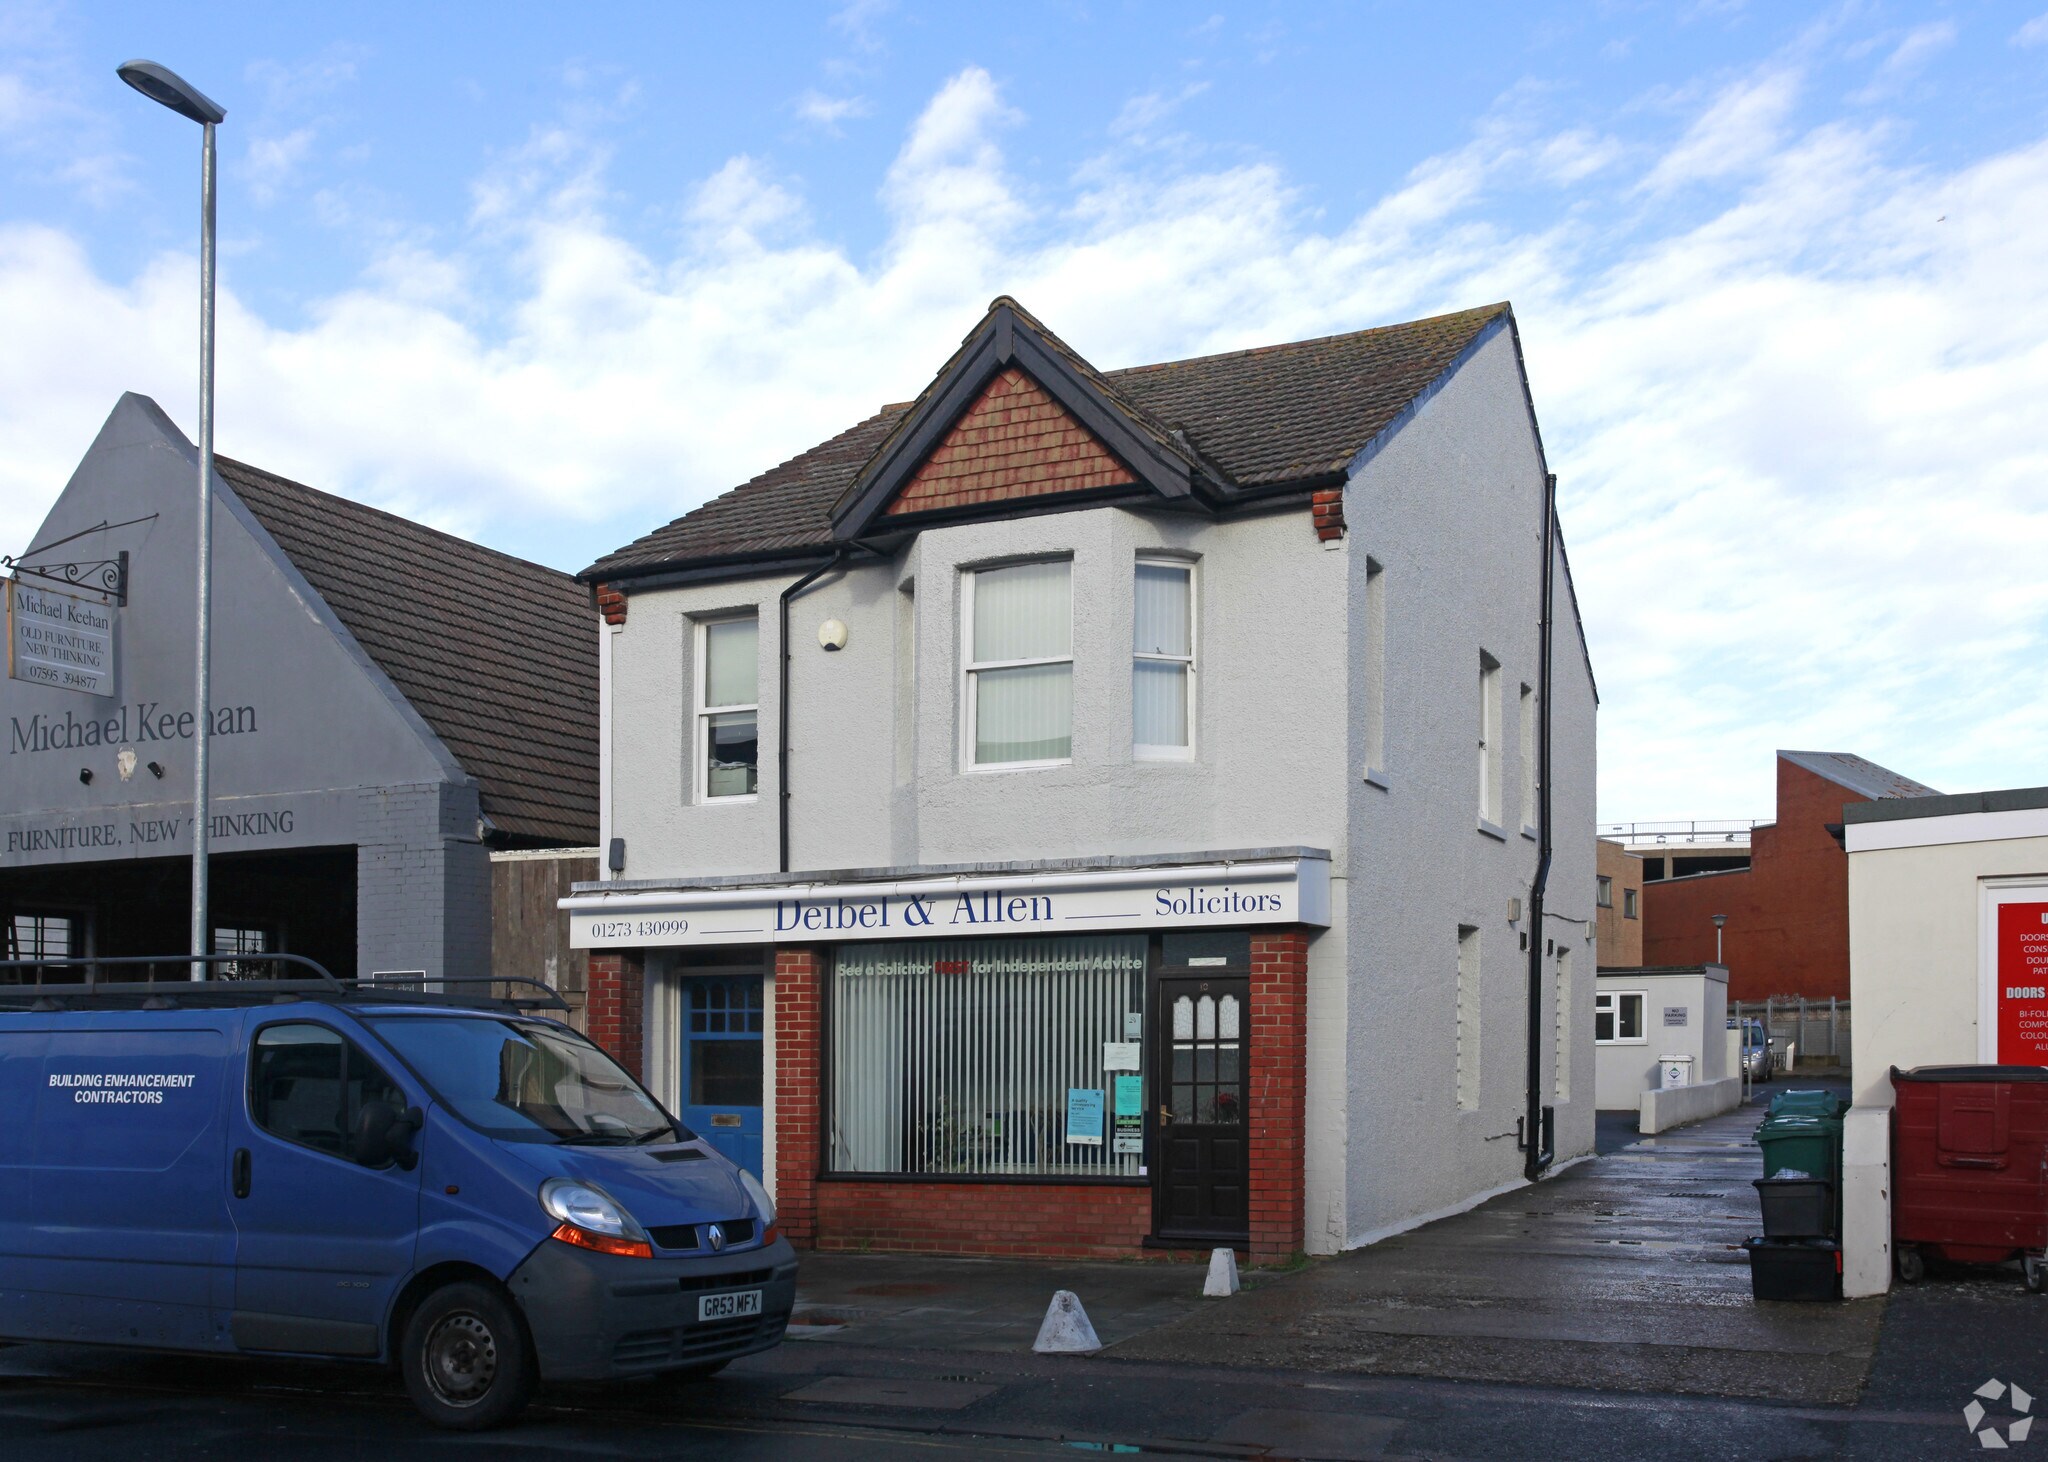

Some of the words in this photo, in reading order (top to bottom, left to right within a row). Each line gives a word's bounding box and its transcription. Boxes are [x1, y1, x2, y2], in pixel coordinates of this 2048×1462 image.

[17, 593, 62, 619] Michael
[67, 604, 109, 630] Keehan
[21, 625, 42, 640] OLD
[26, 642, 49, 656] NEW
[51, 646, 100, 667] THINKING
[29, 665, 59, 681] 07595
[62, 672, 97, 689] 394877
[10, 705, 129, 754] Michael
[8, 824, 122, 852] FURNITURE,
[129, 819, 180, 844] NEW
[188, 810, 294, 839] HINKING
[592, 922, 632, 938] 01273
[636, 920, 689, 936] 430999
[774, 896, 891, 931] Deibel
[903, 893, 936, 927] &
[949, 889, 1054, 925] Allen
[1155, 887, 1282, 916] Solicitors
[838, 963, 863, 977] See
[865, 966, 874, 976] a
[875, 961, 932, 976] Solicitor
[934, 960, 970, 975] FIRST
[971, 959, 993, 974] for
[996, 956, 1090, 976] Independent
[1092, 956, 1143, 970] Advice
[2026, 956, 2048, 965] DOU
[2006, 987, 2046, 999] DOORS
[2019, 1009, 2048, 1018] BI-FOL
[49, 1074, 103, 1087] BUILDING
[104, 1074, 195, 1088] ENHANCEMENT
[74, 1090, 163, 1104] CONTRACTORS
[704, 1296, 734, 1317] GR53
[736, 1293, 758, 1313] MFX
